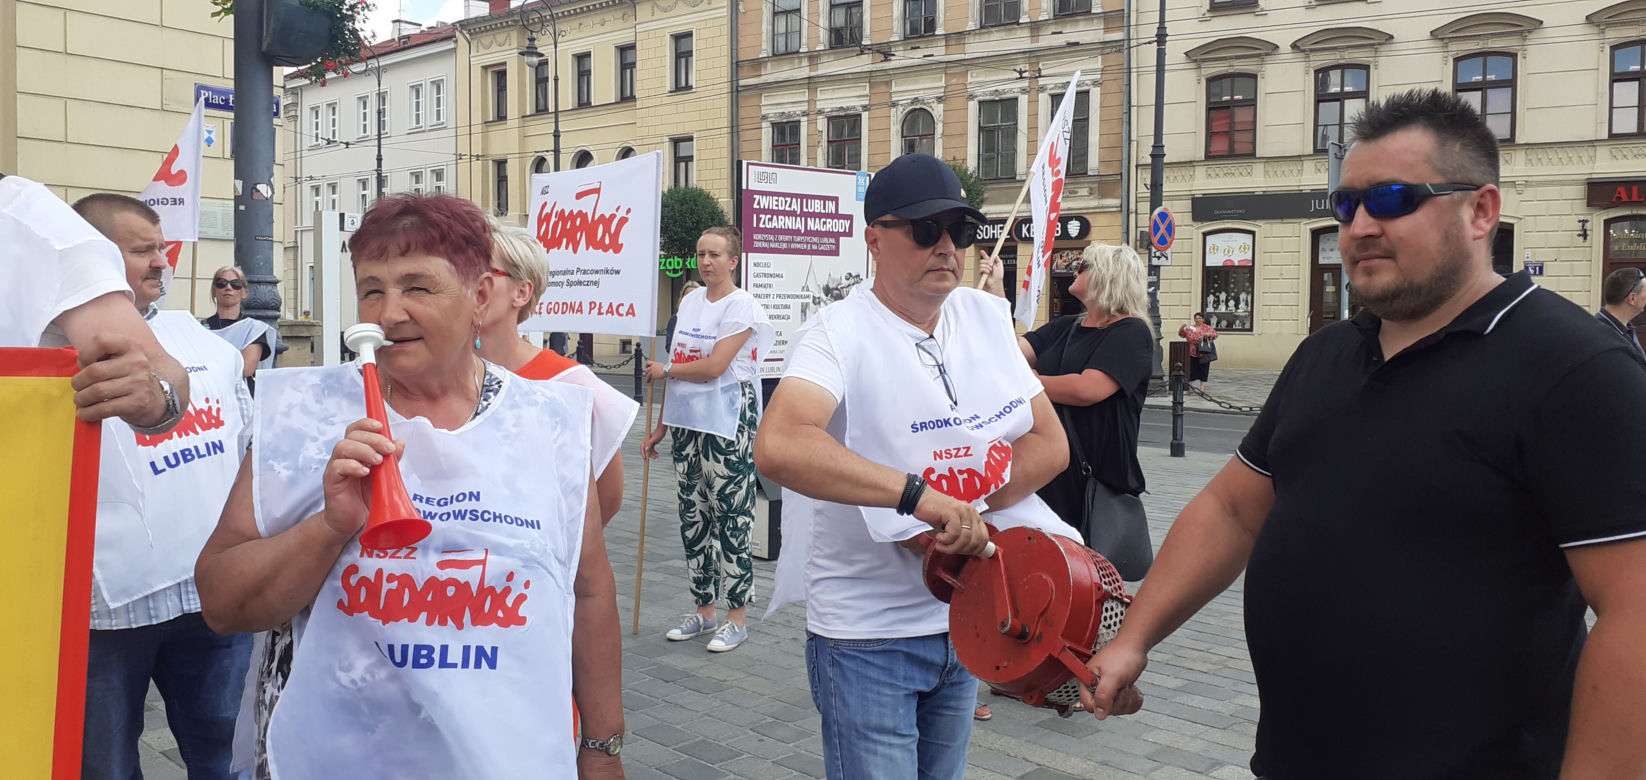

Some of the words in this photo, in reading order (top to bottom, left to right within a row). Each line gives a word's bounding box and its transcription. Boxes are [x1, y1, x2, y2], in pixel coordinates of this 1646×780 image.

[200, 90, 225, 105] Plac
[753, 195, 801, 214] ZWIEDZAJ
[803, 199, 836, 214] LUBLIN
[753, 214, 757, 228] I
[759, 214, 805, 233] ZGARNIAJ
[807, 217, 851, 232] NAGRODY
[548, 267, 575, 278] egionalna
[576, 266, 621, 276] Pracowników
[547, 280, 565, 288] omocy
[566, 278, 600, 288] Społecznej
[546, 301, 583, 315] GODNA
[588, 301, 636, 317] PŁACA
[149, 440, 225, 475] LUBLIN
[933, 446, 973, 461] NSZZ
[412, 491, 481, 508] REGION
[375, 642, 498, 670] UBLIN
